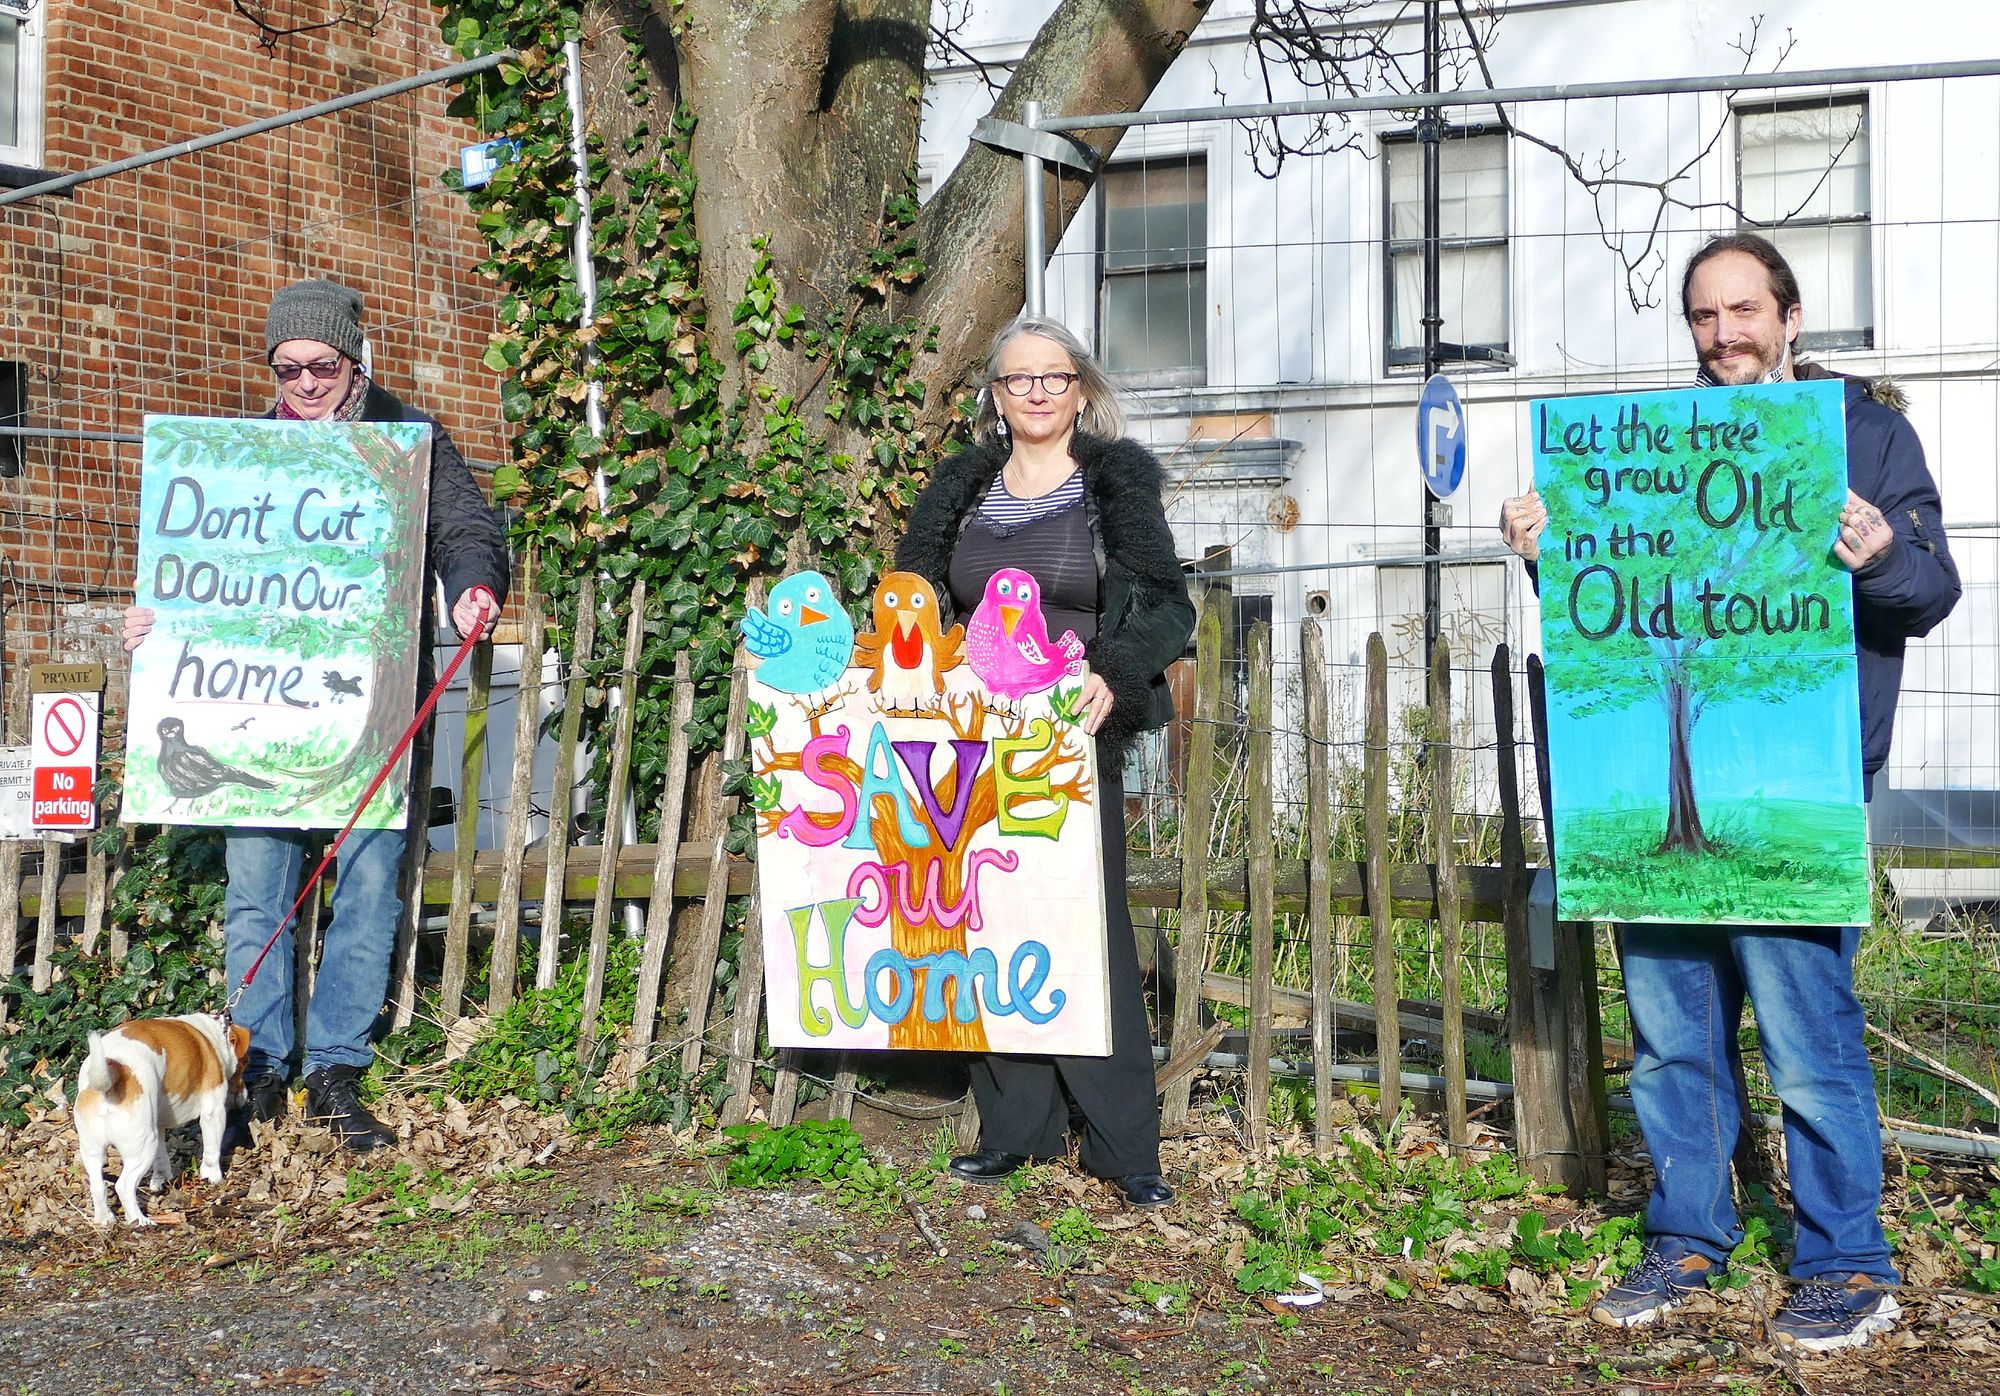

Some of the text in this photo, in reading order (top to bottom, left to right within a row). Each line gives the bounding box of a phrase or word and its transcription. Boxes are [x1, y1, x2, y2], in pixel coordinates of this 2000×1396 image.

[1540, 400, 1761, 455] Let the tree
[156, 476, 366, 544] Don't Cut
[1584, 459, 1803, 532] grow Old
[1564, 523, 1677, 562] in the
[292, 566, 362, 611] Our
[1568, 564, 1684, 641] Old
[1696, 577, 1830, 640] town
[43, 671, 90, 684] PRIVATE
[0, 760, 25, 769] RIVATE
[0, 776, 23, 785] ERMIT
[52, 772, 75, 790] No
[777, 717, 1069, 853] SAVE
[16, 790, 31, 799] ON
[34, 796, 90, 819] parking
[846, 848, 1019, 931] our
[784, 896, 1067, 1037] Home
